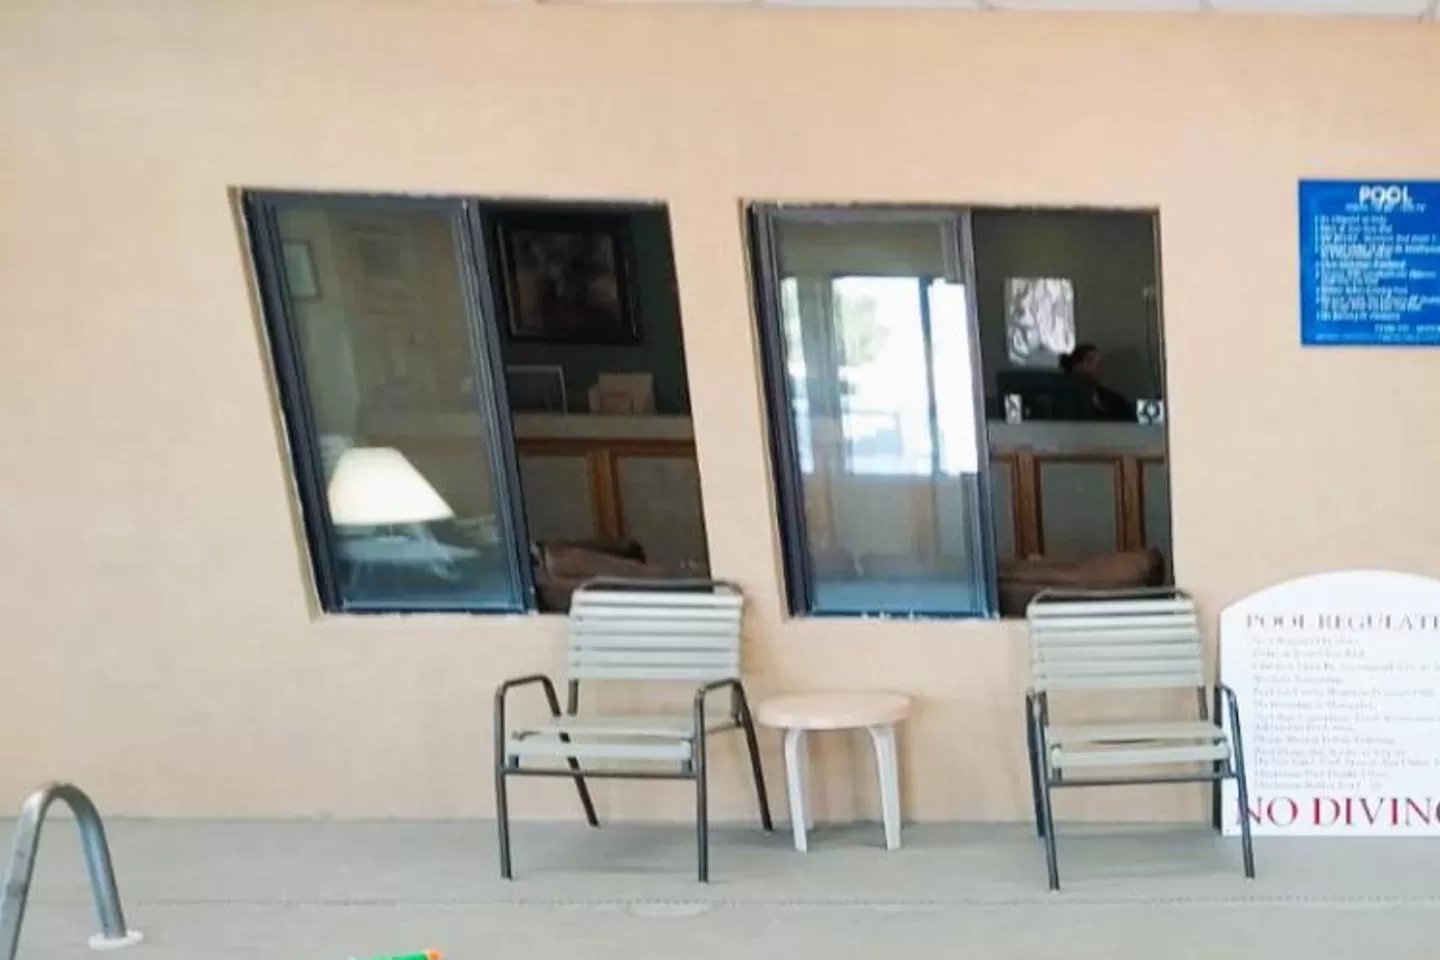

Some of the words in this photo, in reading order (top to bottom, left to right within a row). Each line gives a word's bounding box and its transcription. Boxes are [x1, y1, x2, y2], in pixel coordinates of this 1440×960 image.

[1358, 185, 1412, 204] POOL
[1246, 613, 1305, 630] POOL
[1235, 796, 1299, 828] NO
